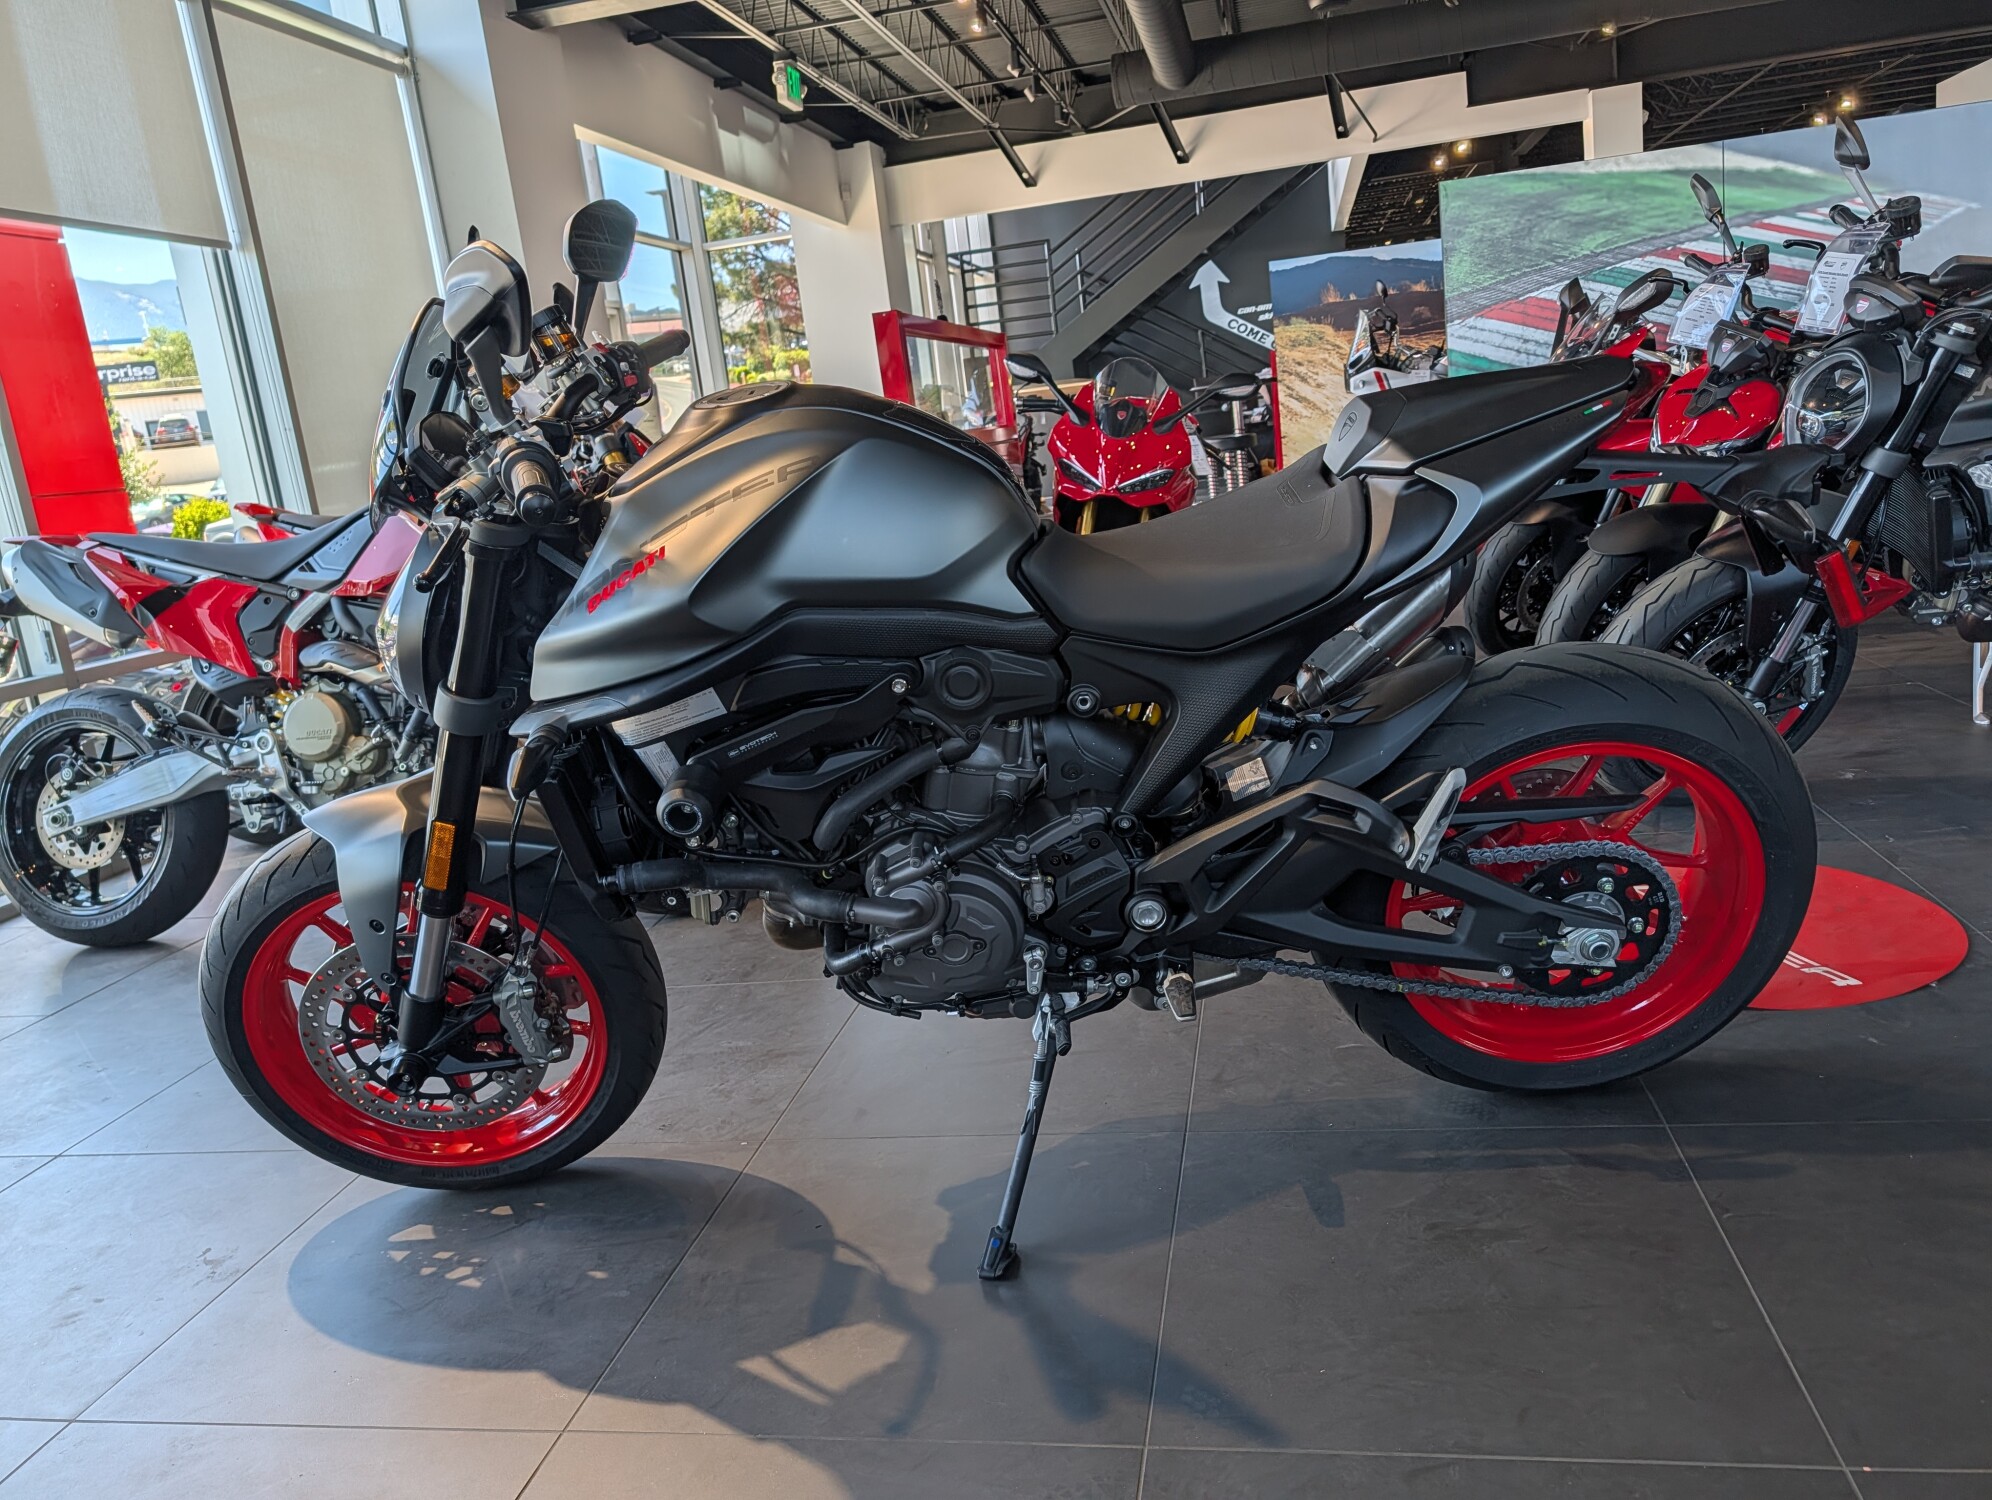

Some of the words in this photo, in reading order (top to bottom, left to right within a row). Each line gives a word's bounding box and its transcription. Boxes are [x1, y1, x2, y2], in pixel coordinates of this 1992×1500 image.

[1237, 303, 1273, 315] can-am
[1228, 319, 1270, 344] COME
[98, 364, 156, 382] rprise
[587, 546, 665, 615] DUCATI
[509, 1009, 536, 1053] brembo
